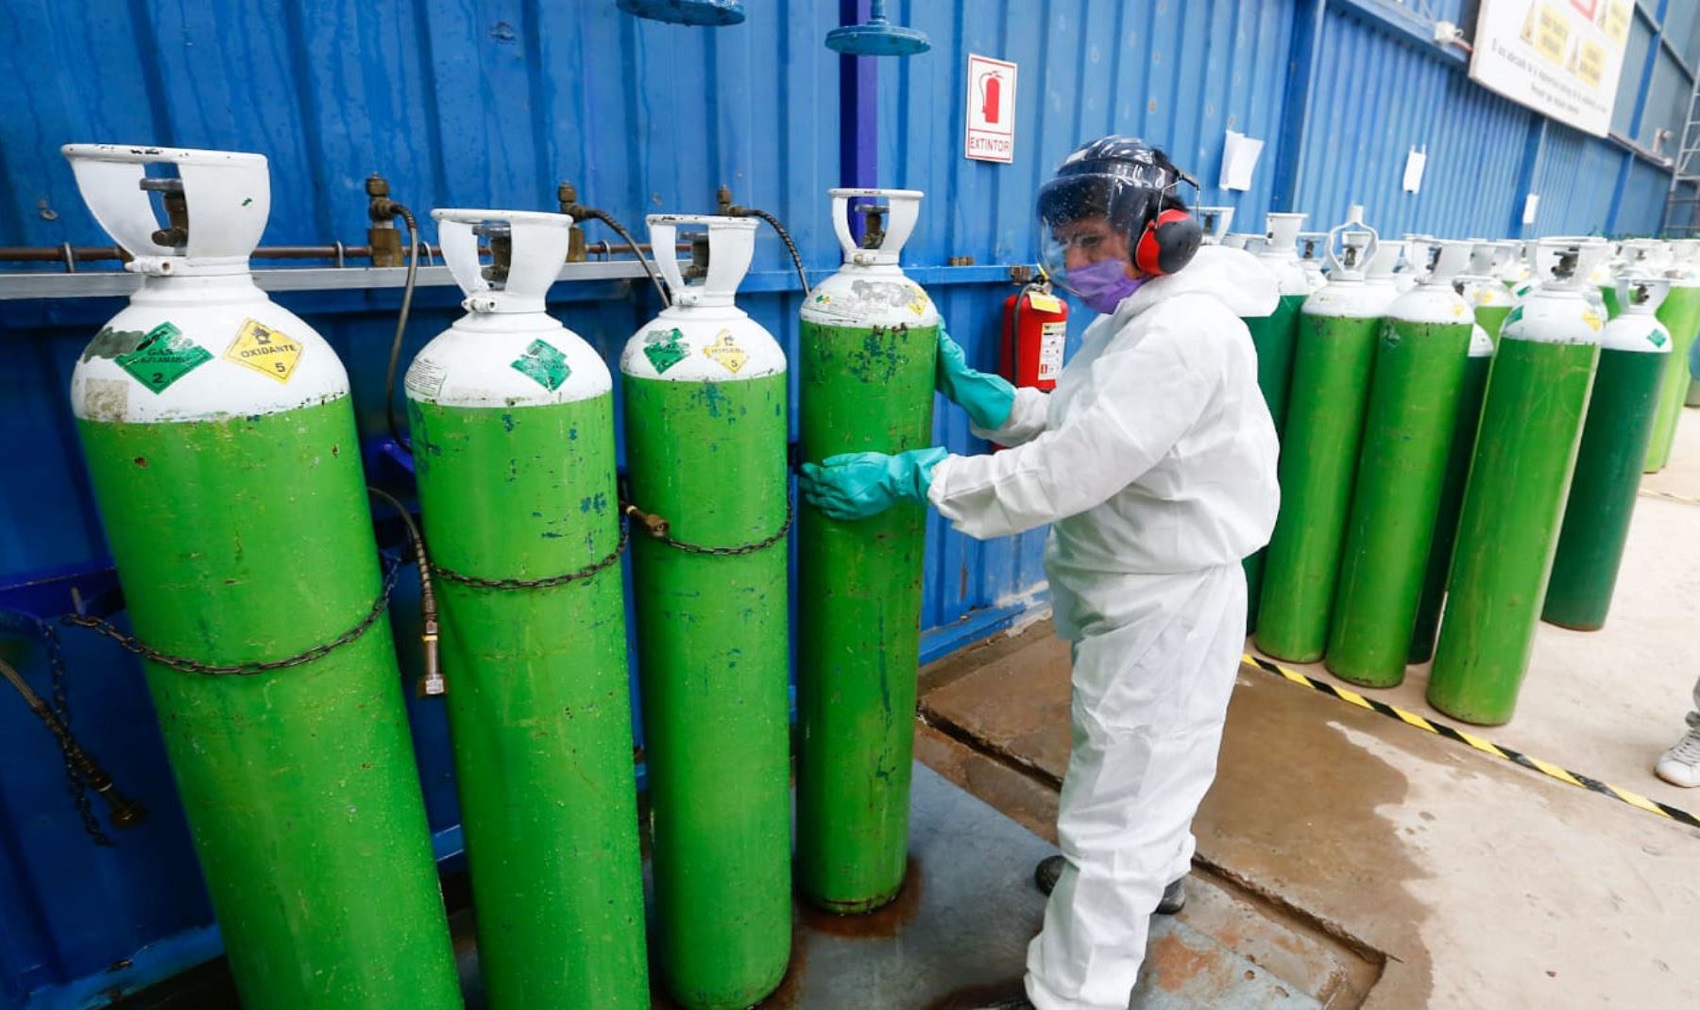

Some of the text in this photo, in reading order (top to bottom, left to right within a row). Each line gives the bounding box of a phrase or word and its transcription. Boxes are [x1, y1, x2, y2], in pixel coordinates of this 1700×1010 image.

[970, 137, 1010, 152] EXTINTOR
[147, 348, 173, 356] GAS
[240, 344, 297, 358] OXIDANTE
[275, 362, 286, 373] 5
[152, 372, 164, 384] 2
